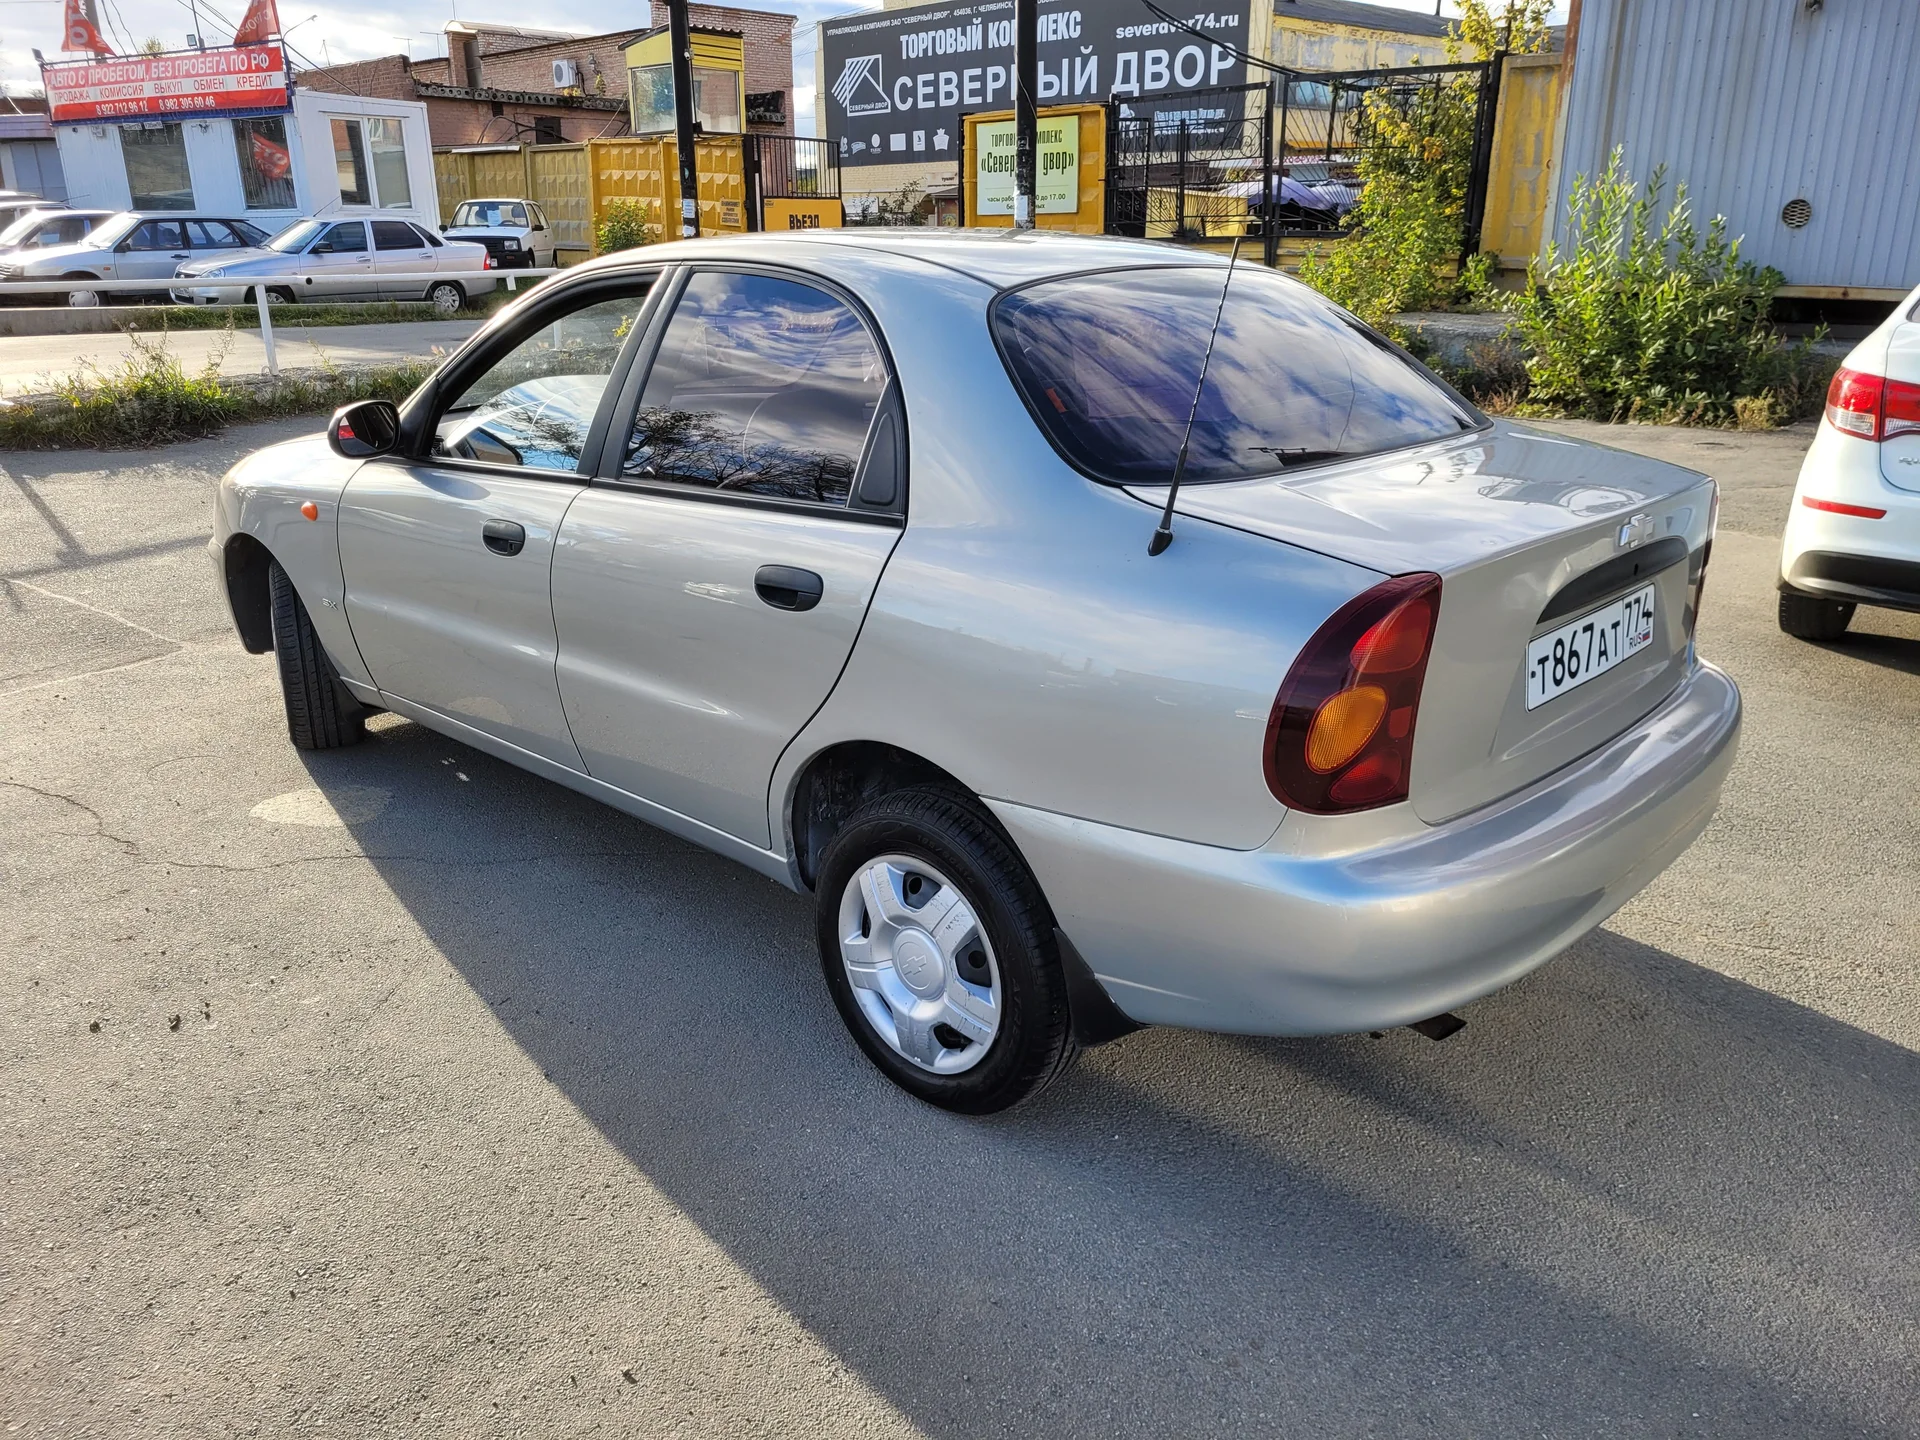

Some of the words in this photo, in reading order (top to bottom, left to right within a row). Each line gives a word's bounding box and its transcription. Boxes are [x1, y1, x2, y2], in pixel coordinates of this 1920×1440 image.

[826, 25, 863, 36] УПРАВЛЯЮЩАЯ
[863, 20, 890, 30] КОМПАНИЯ
[890, 18, 901, 26] ЗАО
[978, 1, 1014, 12] ЧЕЛЯБИНСК,
[900, 17, 982, 60] ТОРГОВЫЙ
[988, 10, 1082, 49] КОЛЕКС
[50, 71, 76, 87] АВТО
[78, 69, 86, 85] С
[88, 64, 149, 85] ПРОБЕГОМ,
[151, 62, 172, 78] БЕЗ
[175, 56, 228, 76] ПРОБЕГА
[230, 54, 247, 72] ПО
[250, 53, 269, 70] РФ
[893, 44, 1098, 111] СЕВЕРЫЙ
[1111, 42, 1237, 97] ДВОР
[54, 90, 91, 104] ПРОДАЖА
[100, 84, 144, 99] КОМИССИЯ
[154, 81, 183, 94] ВЫКУП
[193, 78, 225, 91] ОБМЕН
[236, 74, 272, 90] КРЕДИТ
[96, 105, 101, 115] 8
[101, 104, 114, 115] 922
[115, 102, 128, 113] 712
[128, 101, 138, 112] 96
[140, 100, 148, 112] 12
[159, 100, 165, 111] 8
[165, 98, 179, 110] 982
[180, 97, 194, 108] 305
[195, 96, 204, 108] 60
[205, 95, 215, 107] 46
[850, 102, 874, 111] СЕВЕРНЫЙ
[875, 101, 888, 109] ДВОР
[991, 132, 1016, 147] ТОРГОВ
[1036, 129, 1063, 144] МПЛЕКС
[981, 152, 1015, 177] «Север
[1043, 151, 1074, 176] двор»
[1001, 194, 1014, 203] рабо
[1049, 193, 1066, 201] 17.00
[1536, 620, 1621, 695] Т867АТ
[1624, 592, 1652, 638] 774
[1629, 632, 1643, 649] RUS
